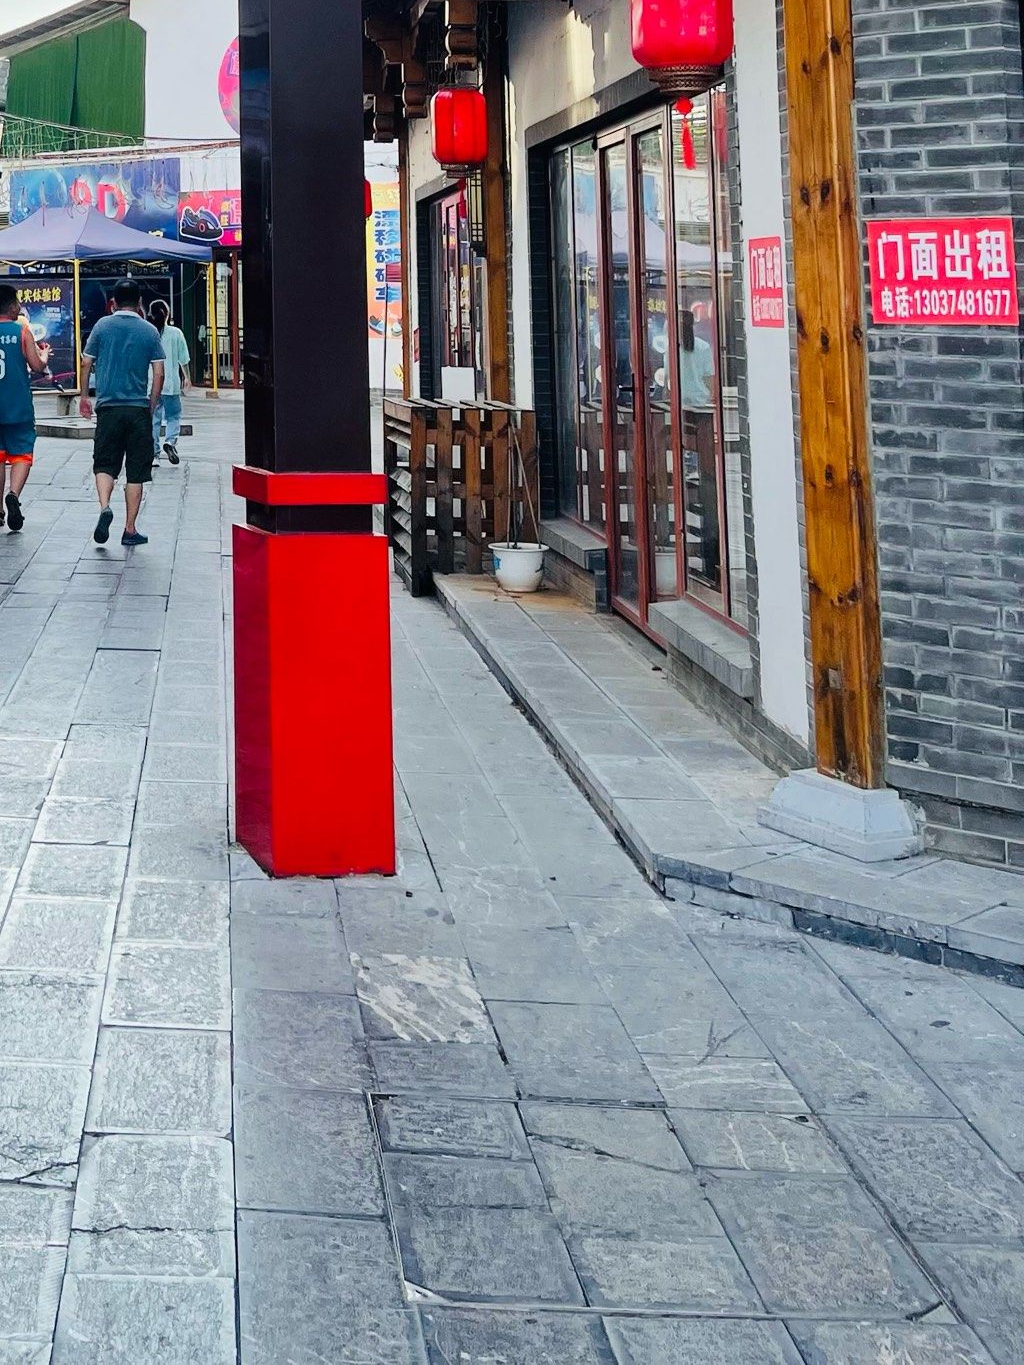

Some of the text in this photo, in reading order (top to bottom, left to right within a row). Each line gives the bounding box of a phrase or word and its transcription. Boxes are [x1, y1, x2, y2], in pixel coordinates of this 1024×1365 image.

[750, 246, 782, 290] 门面出租
[877, 229, 1010, 281] 门面出租
[880, 286, 1011, 318] 电话:13037481677
